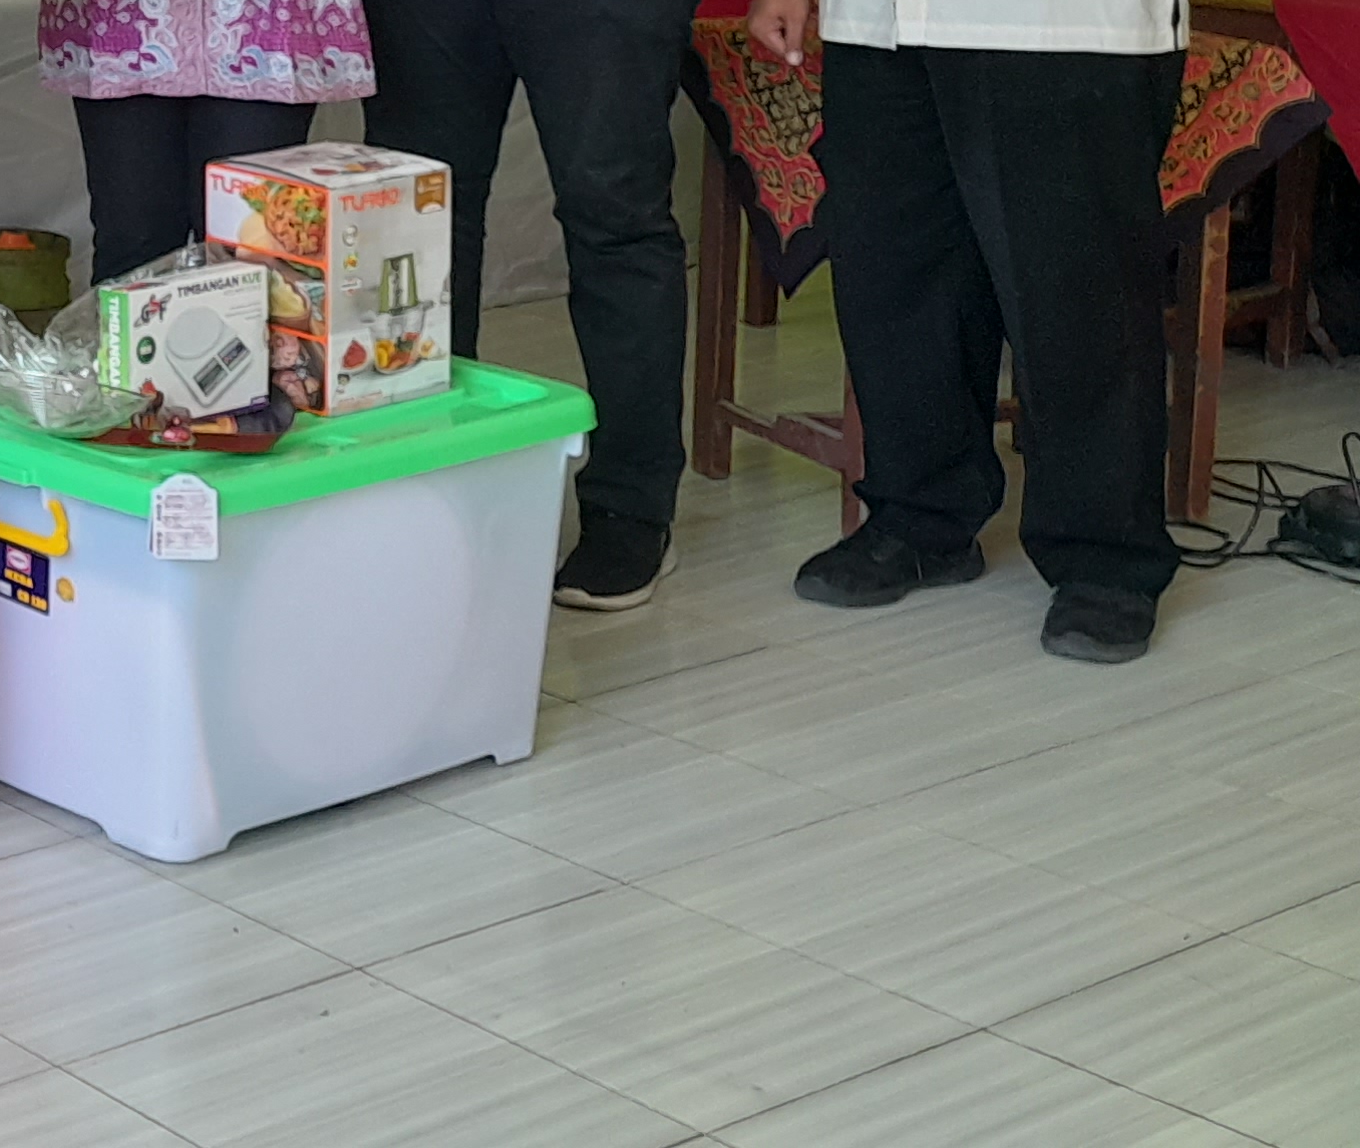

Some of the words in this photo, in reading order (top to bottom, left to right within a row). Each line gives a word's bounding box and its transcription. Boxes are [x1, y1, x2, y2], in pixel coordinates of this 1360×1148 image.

[338, 187, 401, 213] TURBO
[177, 276, 240, 298] TIMBANGAN
[241, 271, 263, 286] KUE
